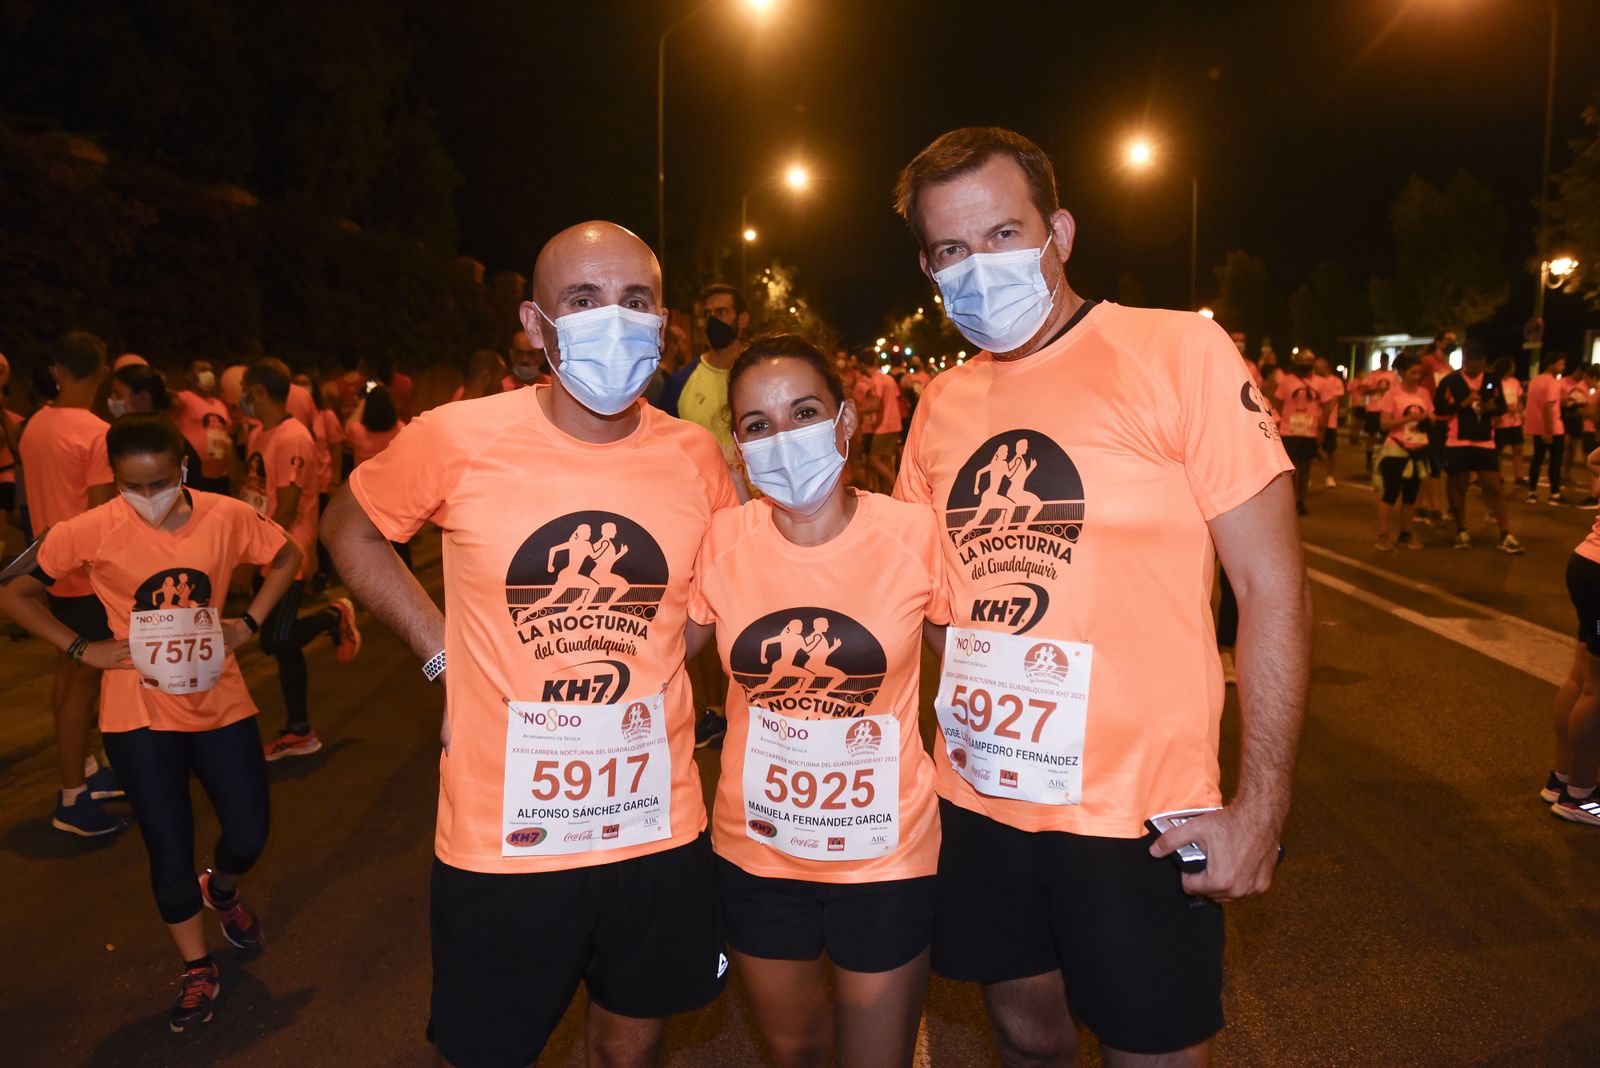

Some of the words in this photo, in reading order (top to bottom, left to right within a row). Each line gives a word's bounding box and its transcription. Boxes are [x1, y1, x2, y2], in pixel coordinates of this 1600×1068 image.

[959, 547, 977, 565] LA
[979, 535, 1073, 564] NOCTURNA
[971, 563, 986, 580] del
[988, 555, 1057, 580] Guadalquivir
[517, 625, 543, 644] LA
[548, 615, 648, 640] NOCTURNA
[145, 637, 213, 664] 7575
[534, 641, 554, 660] del
[555, 635, 638, 656] Guadalquivir
[768, 697, 865, 718] NOCTURNA
[951, 684, 1057, 744] 5927
[944, 727, 961, 739] JOSÉ
[1016, 750, 1078, 766] FERNÁNDEZ
[788, 759, 820, 768] NOCTURNA
[833, 758, 872, 768] GUADALQUIVIR
[532, 753, 650, 801] 5917
[764, 763, 875, 810] 5925
[517, 808, 569, 818] ALFONSO
[572, 803, 621, 818] SÁNCHEZ
[623, 795, 659, 811] GARCÍA
[748, 800, 790, 822] MANUELA
[792, 814, 853, 827] FERNÁNDEZ
[855, 813, 892, 825] GARCIA
